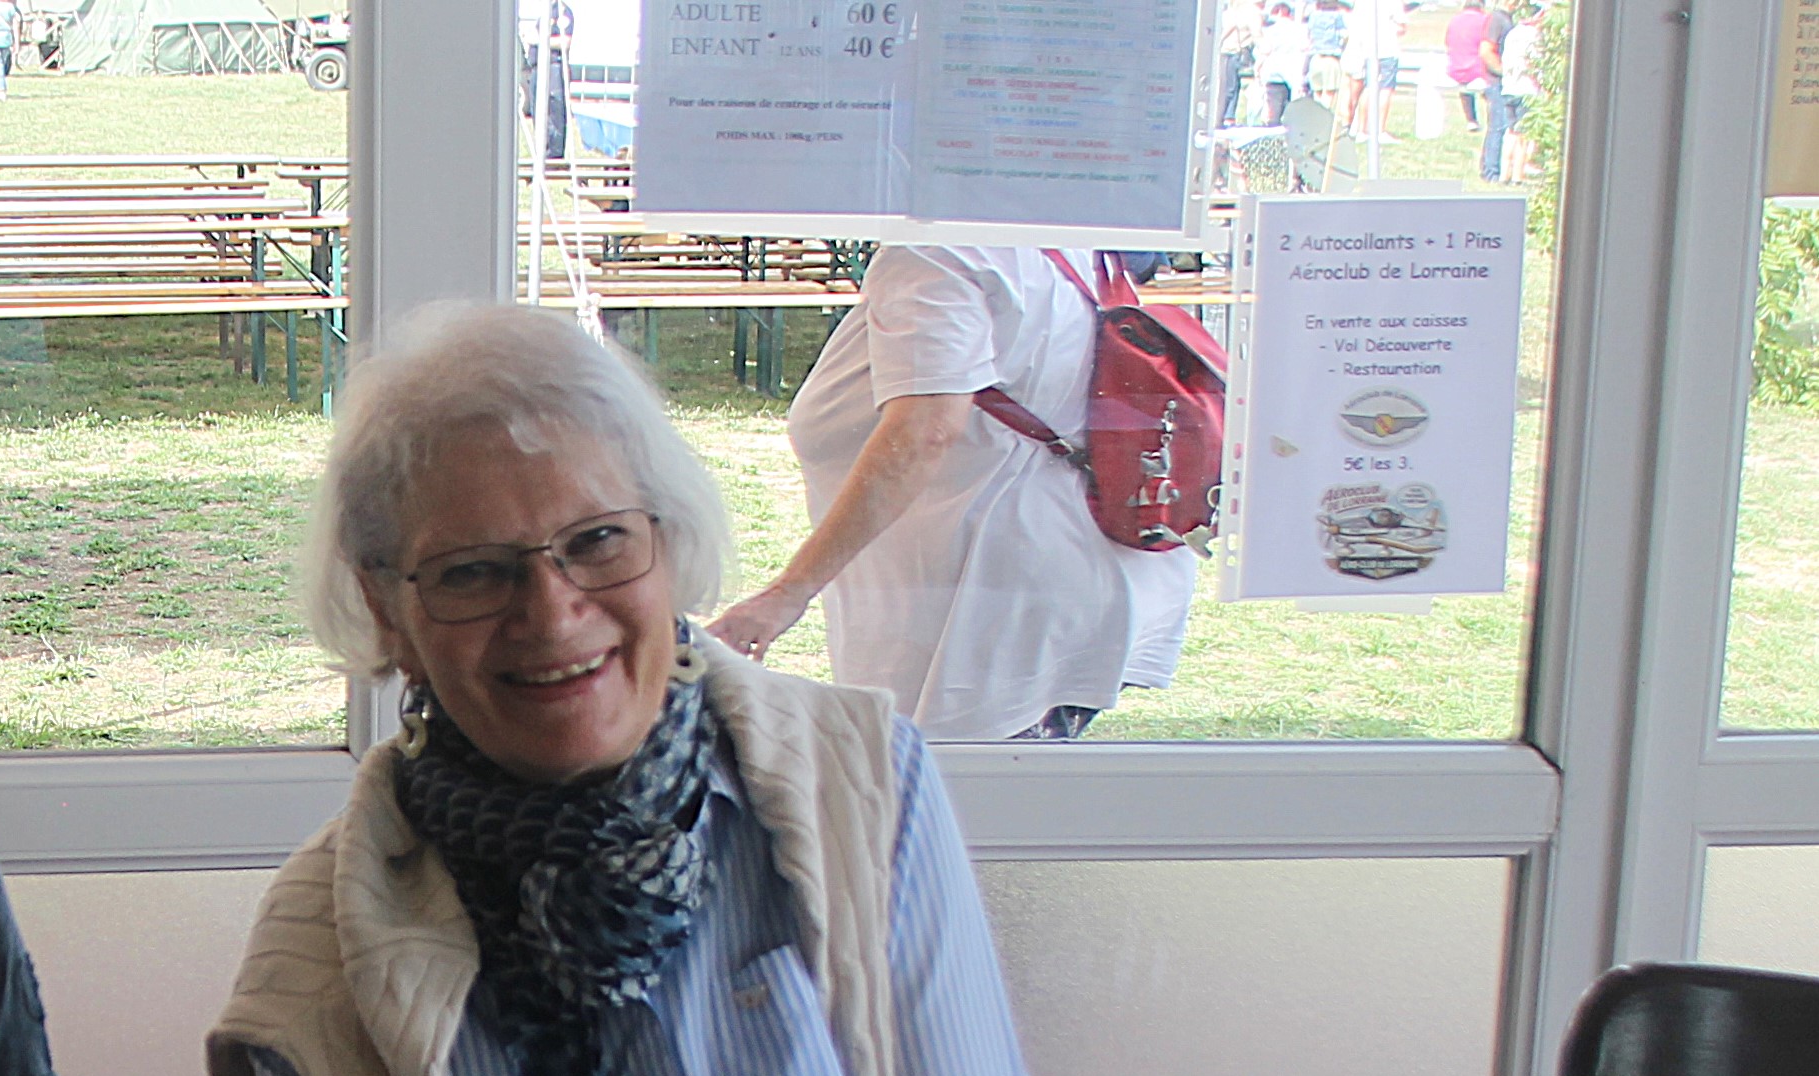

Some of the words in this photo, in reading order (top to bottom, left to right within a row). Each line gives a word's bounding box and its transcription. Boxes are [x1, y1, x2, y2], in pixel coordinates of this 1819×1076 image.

[670, 4, 761, 22] ADULTE
[847, 2, 875, 24] 60
[883, 3, 897, 24] €
[670, 37, 761, 56] ENFANT
[781, 46, 791, 57] 12
[797, 46, 822, 57] ANS
[843, 36, 872, 58] 40
[880, 37, 895, 58] €
[668, 97, 694, 107] Pour
[698, 97, 715, 107] des
[718, 98, 756, 108] raisons
[759, 98, 772, 108] de
[773, 99, 819, 110] centrage
[823, 100, 833, 109] et
[835, 99, 848, 109] de
[716, 130, 748, 140] POIDS
[751, 130, 776, 140] MAX
[1280, 234, 1291, 251] 2
[1300, 232, 1414, 251] Autocollants
[1424, 237, 1435, 247] +
[1446, 232, 1454, 249] 1
[1464, 232, 1503, 249] Pins
[1289, 262, 1370, 281] Aéroclub
[1379, 262, 1401, 280] de
[1410, 261, 1489, 280] Lorraine
[1305, 314, 1323, 330] En
[1330, 315, 1372, 329] vente
[1379, 316, 1406, 329] aux
[1412, 313, 1468, 328] caisses
[1334, 337, 1358, 353] Vol
[1365, 335, 1452, 352] Découverte
[1343, 361, 1441, 377] Restauration
[1344, 456, 1363, 471] 5€
[1370, 455, 1391, 471] les
